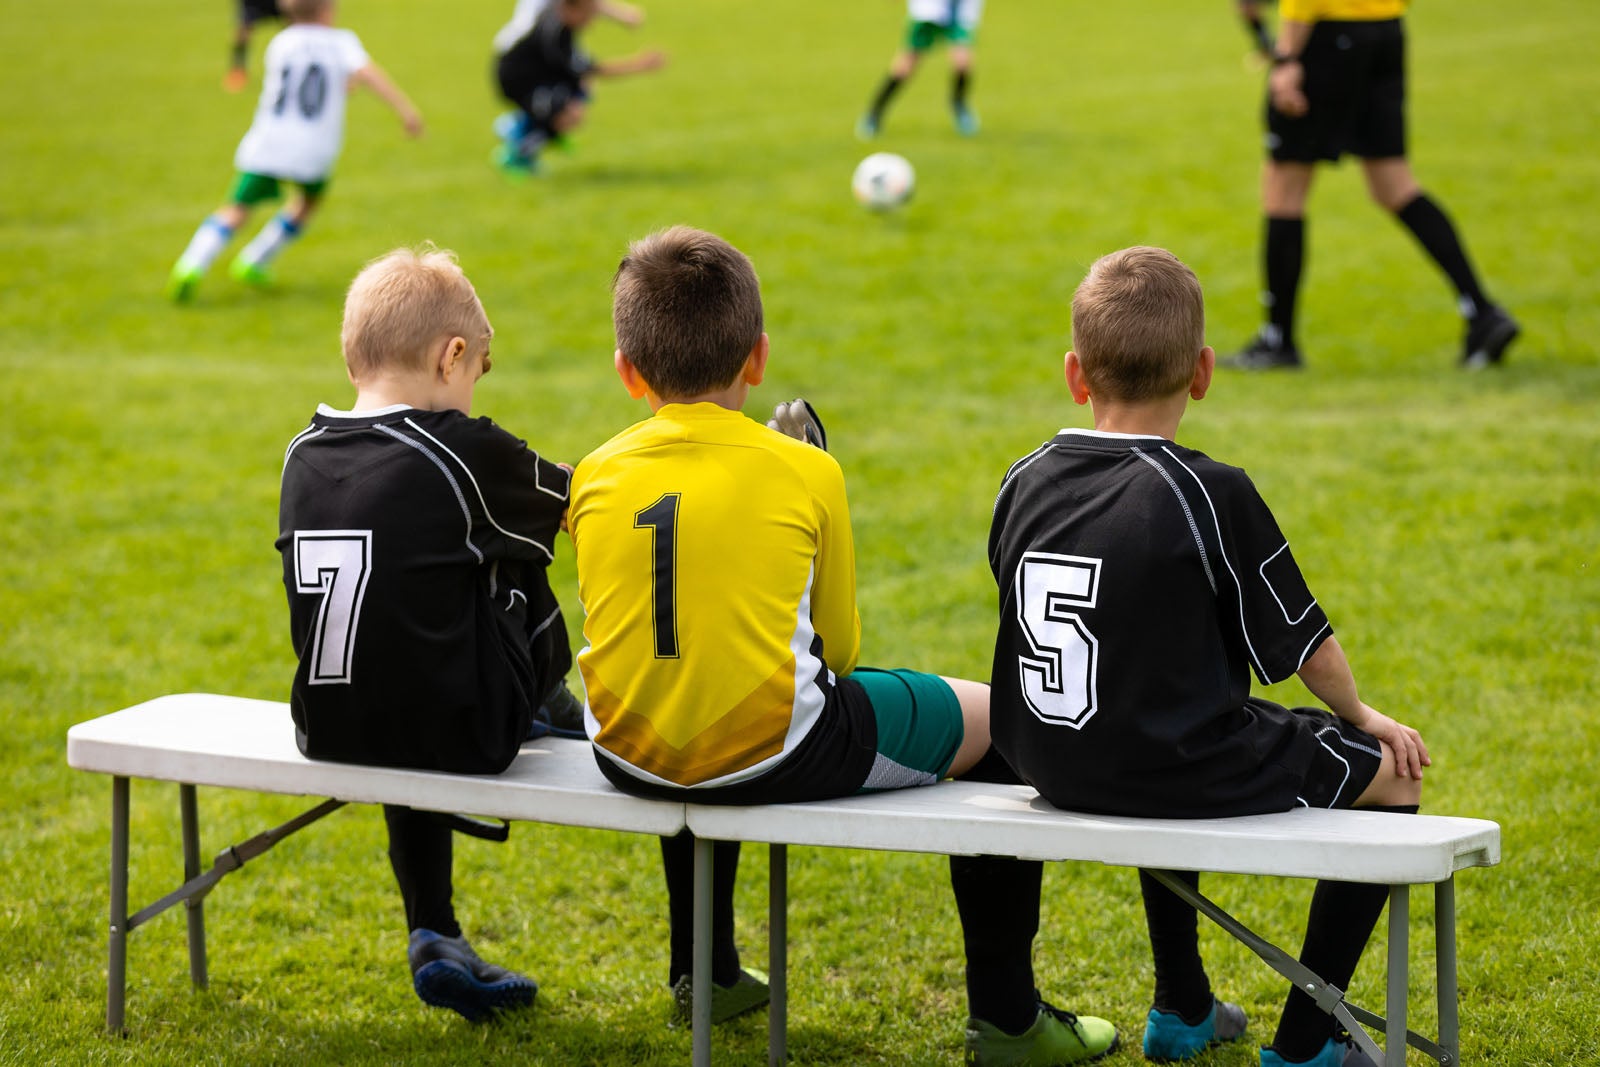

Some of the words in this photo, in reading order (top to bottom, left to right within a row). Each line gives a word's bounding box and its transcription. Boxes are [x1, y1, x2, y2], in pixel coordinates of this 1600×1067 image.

[273, 62, 329, 120] 10
[294, 529, 373, 685] 7
[633, 493, 681, 659] 1
[1015, 551, 1102, 731] 5
